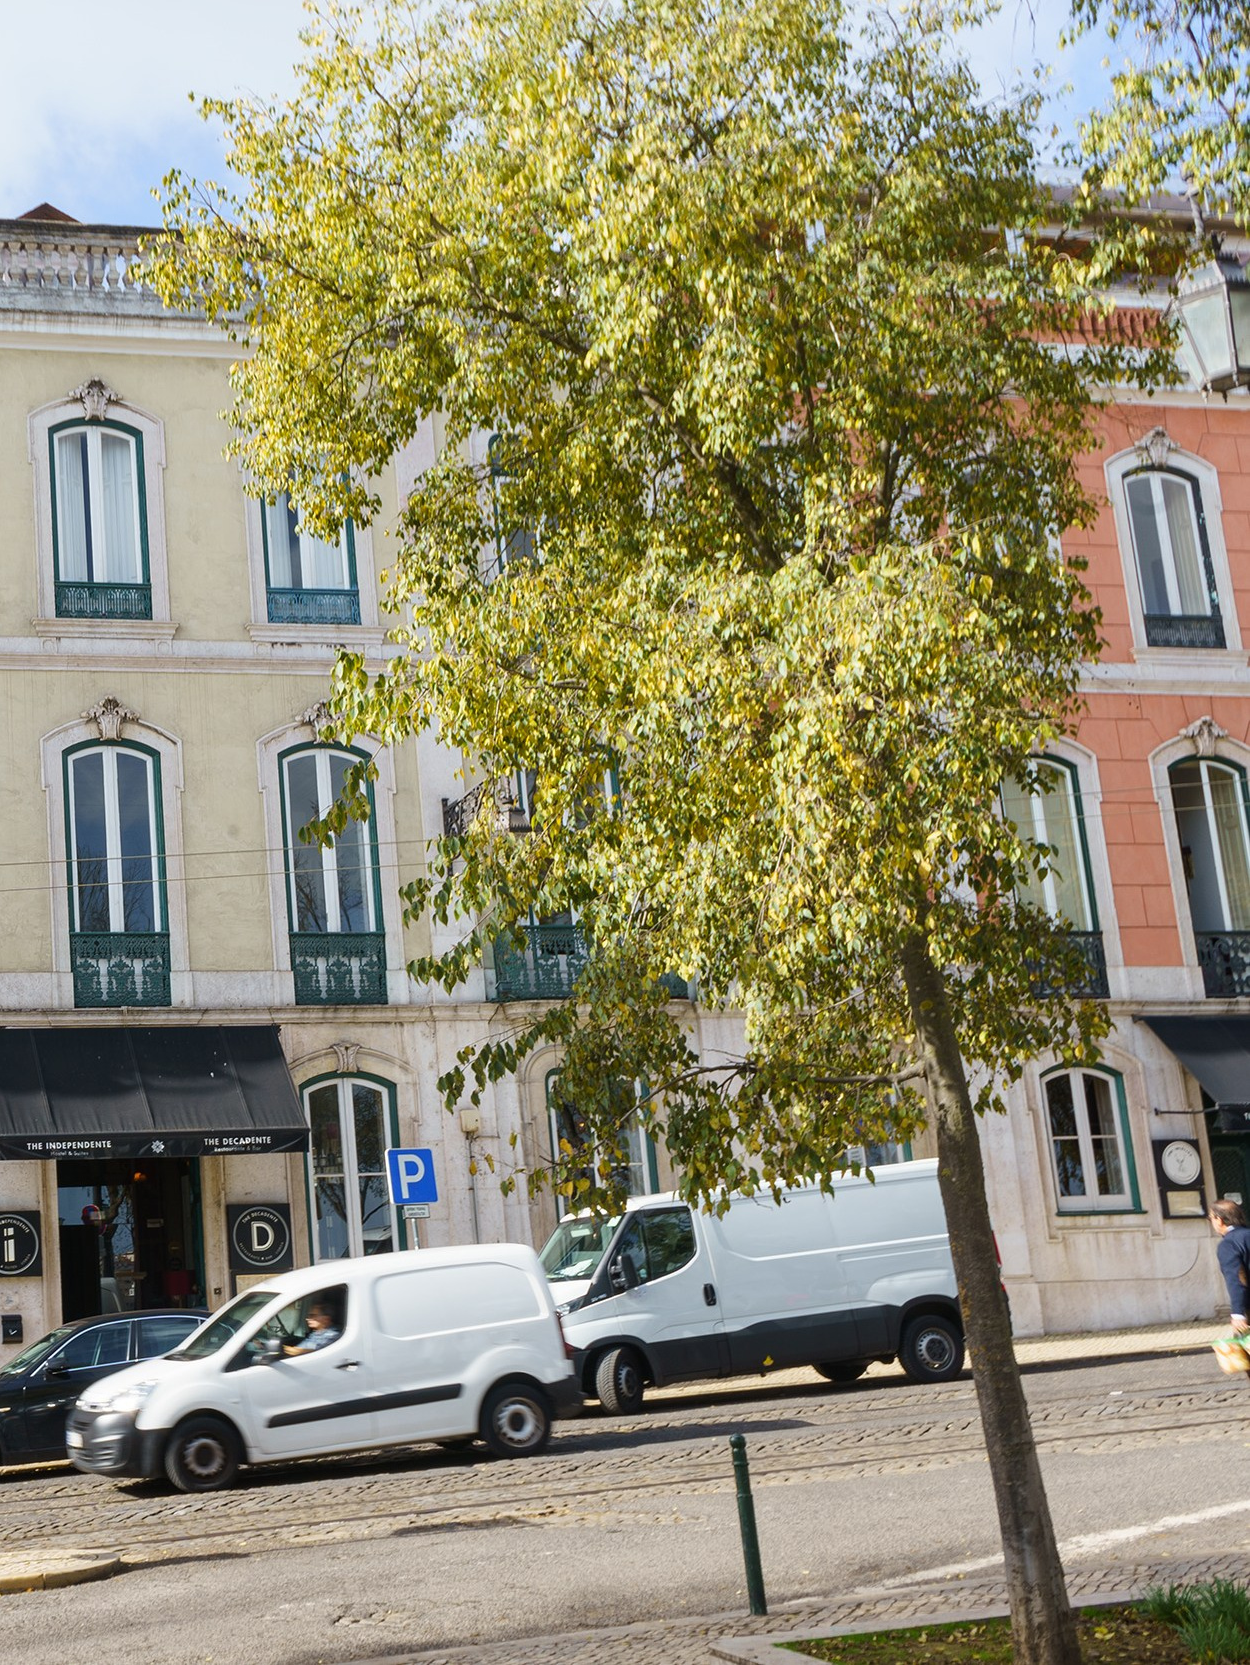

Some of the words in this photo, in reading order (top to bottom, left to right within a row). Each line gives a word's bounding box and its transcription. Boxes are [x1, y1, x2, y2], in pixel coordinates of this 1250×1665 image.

[27, 1142, 43, 1150] THE
[46, 1140, 111, 1150] INDEPENDENTE
[204, 1138, 219, 1146] THE
[222, 1136, 271, 1145] DECADENTE
[397, 1154, 425, 1199] P
[251, 1221, 275, 1251] D
